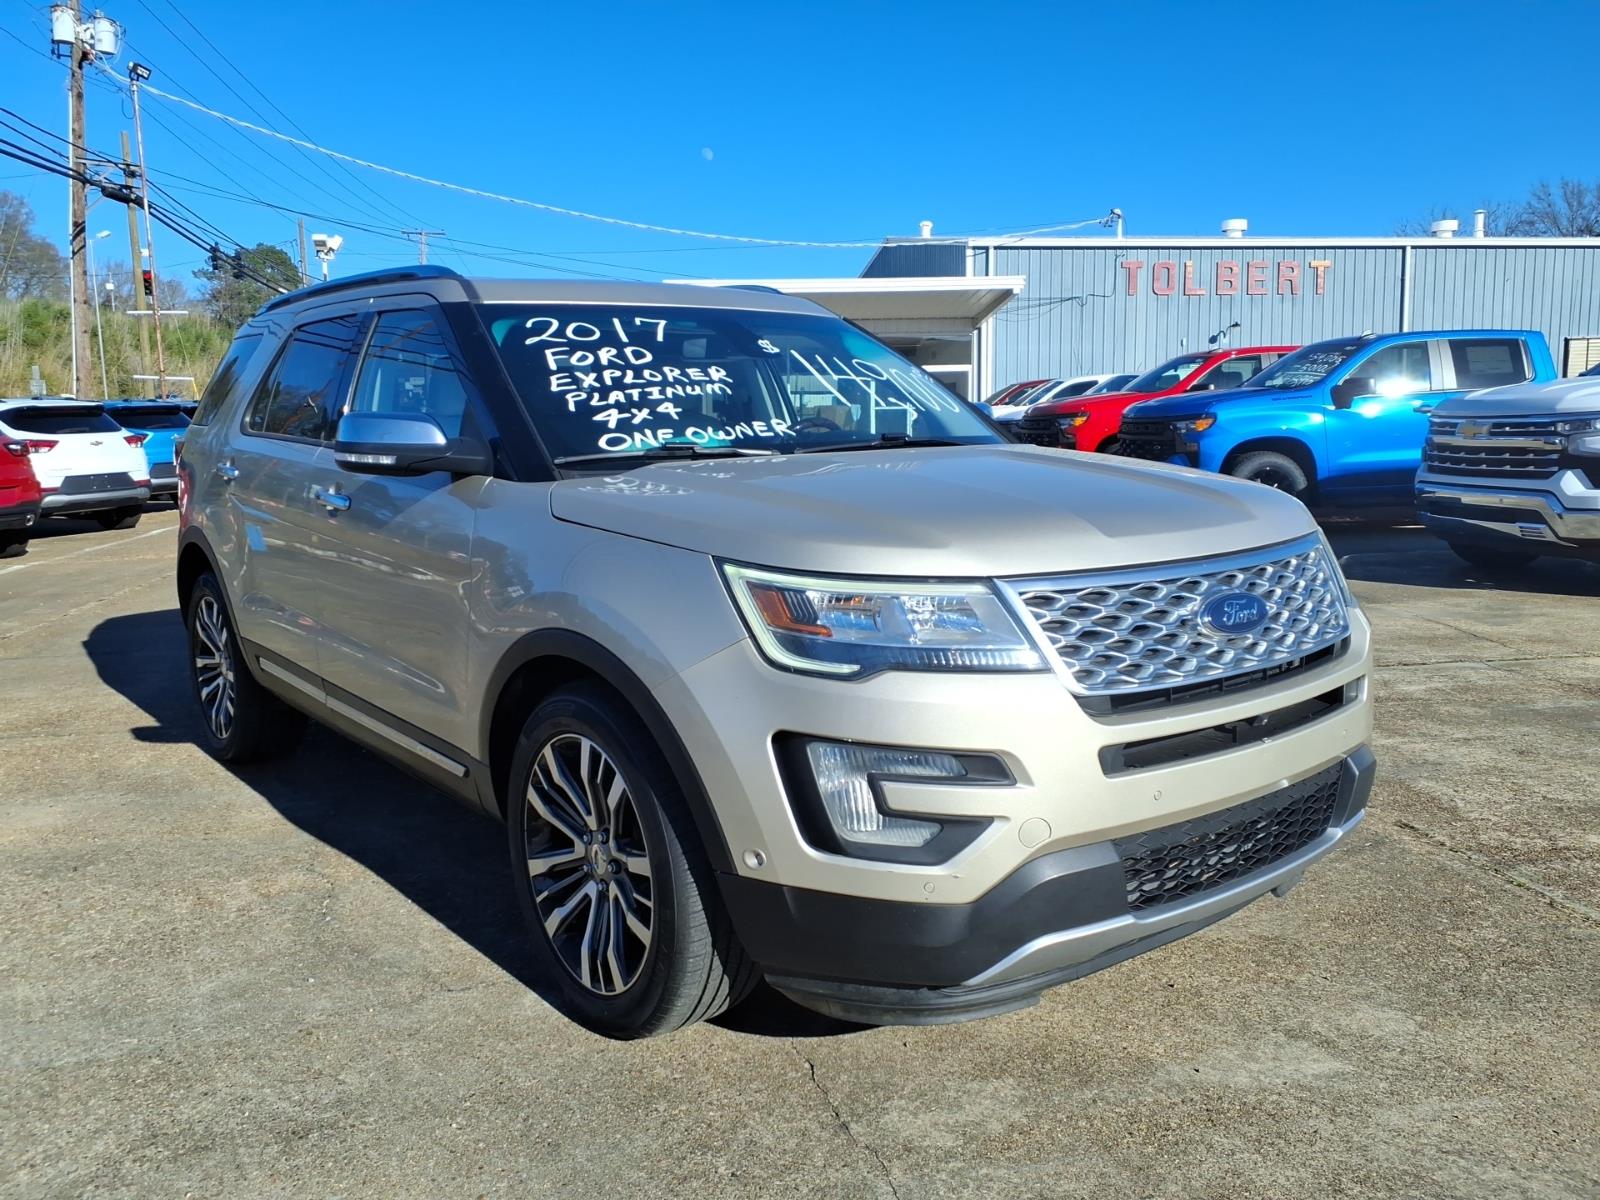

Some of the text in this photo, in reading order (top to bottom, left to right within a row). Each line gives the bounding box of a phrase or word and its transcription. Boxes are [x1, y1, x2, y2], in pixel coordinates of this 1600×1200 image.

[1121, 260, 1333, 297] TOLBERT
[523, 316, 668, 346] 2017
[544, 346, 654, 371] FORD
[548, 365, 734, 393] EXPLORER
[597, 418, 797, 452] ONE OWNER
[1222, 598, 1259, 626] Ford
